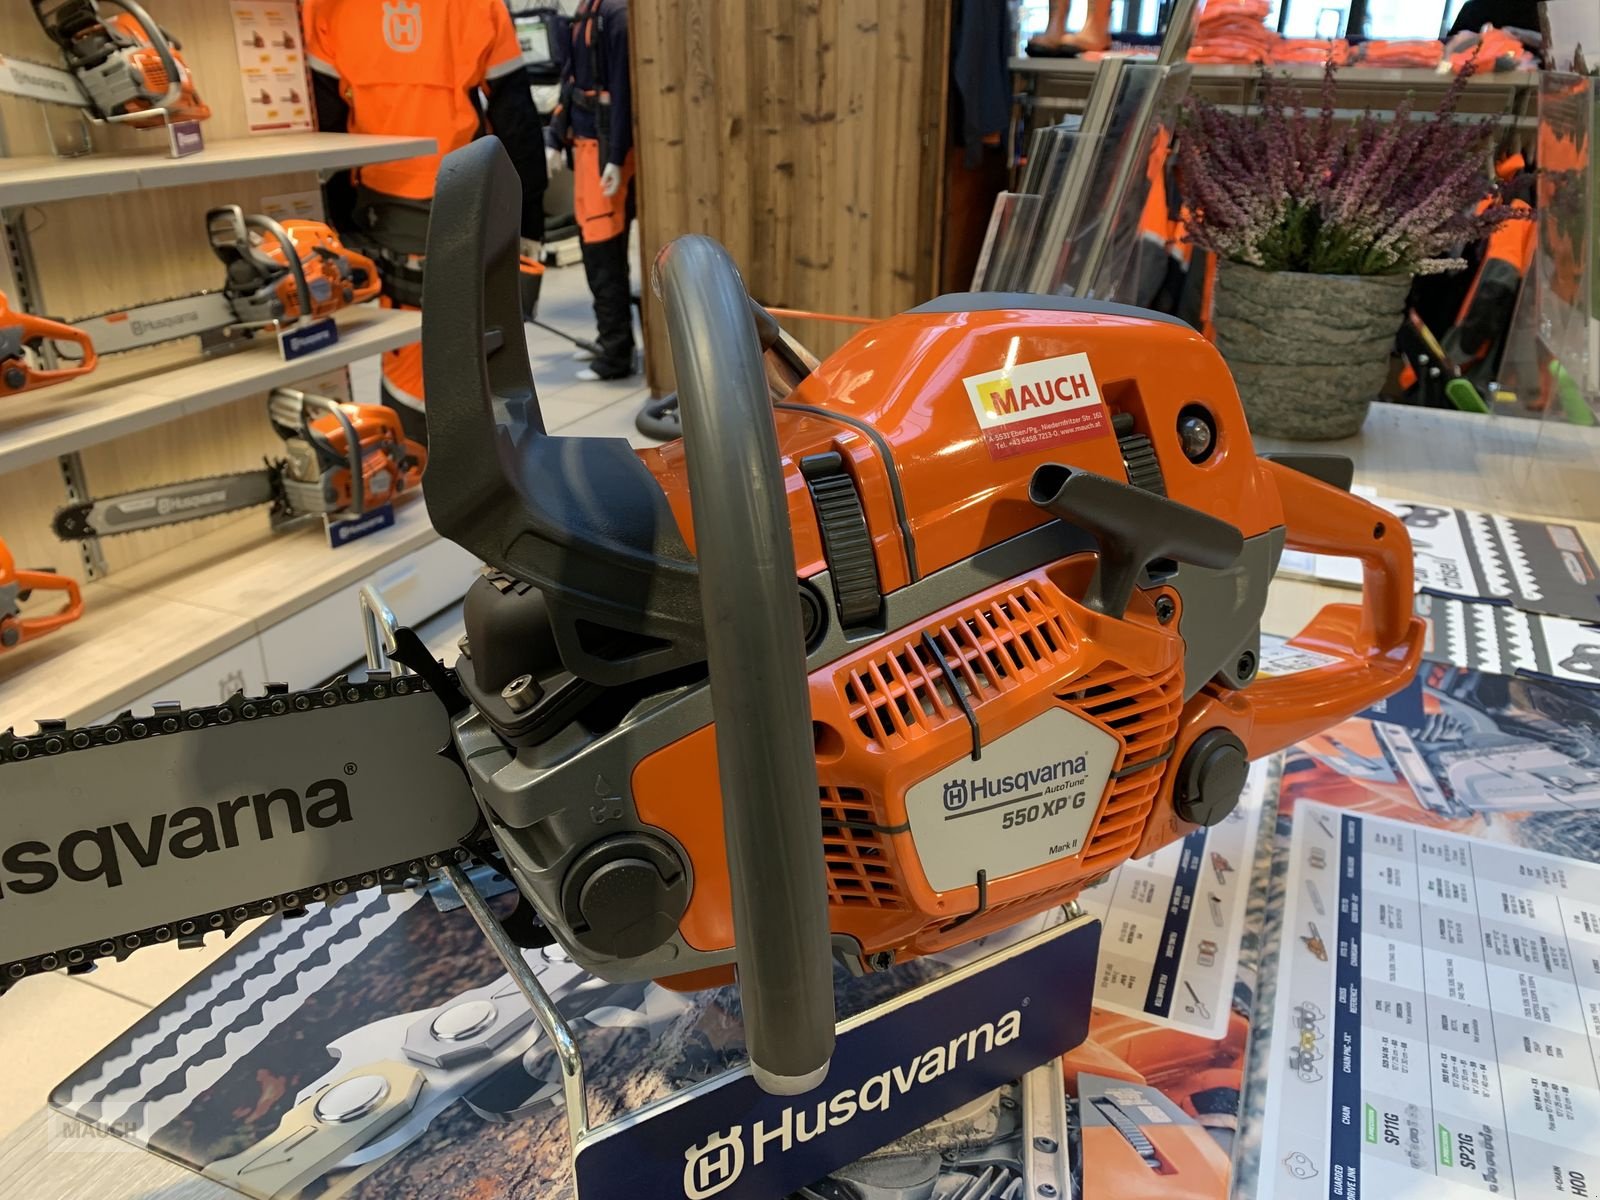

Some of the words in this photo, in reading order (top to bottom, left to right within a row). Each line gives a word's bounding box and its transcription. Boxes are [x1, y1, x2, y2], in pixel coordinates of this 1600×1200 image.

[143, 311, 197, 333] Husqvarna
[990, 373, 1090, 416] MAUCH
[995, 442, 1008, 450] Tel.
[1021, 436, 1037, 444] 6458
[1060, 422, 1101, 435] www.mauch.at
[1041, 418, 1081, 431] Niedernfritzer
[1082, 414, 1091, 423] Str.
[971, 755, 1086, 801] Husqvarna
[1002, 805, 1039, 829] 550
[1072, 792, 1086, 809] G
[0, 778, 353, 900] sqvarna
[1049, 841, 1071, 855] Mark
[1343, 1056, 1351, 1073] CHAIN
[753, 1009, 1022, 1166] Husqvarna
[1342, 1105, 1350, 1125] CHAIN
[1384, 1113, 1399, 1145] SP11G
[1458, 1133, 1476, 1170] SP21G
[1334, 1165, 1343, 1195] GUARDED
[1347, 1166, 1356, 1182] LINK
[1553, 1165, 1565, 1191] H-CHAIN
[1347, 1182, 1356, 1200] DRIVE
